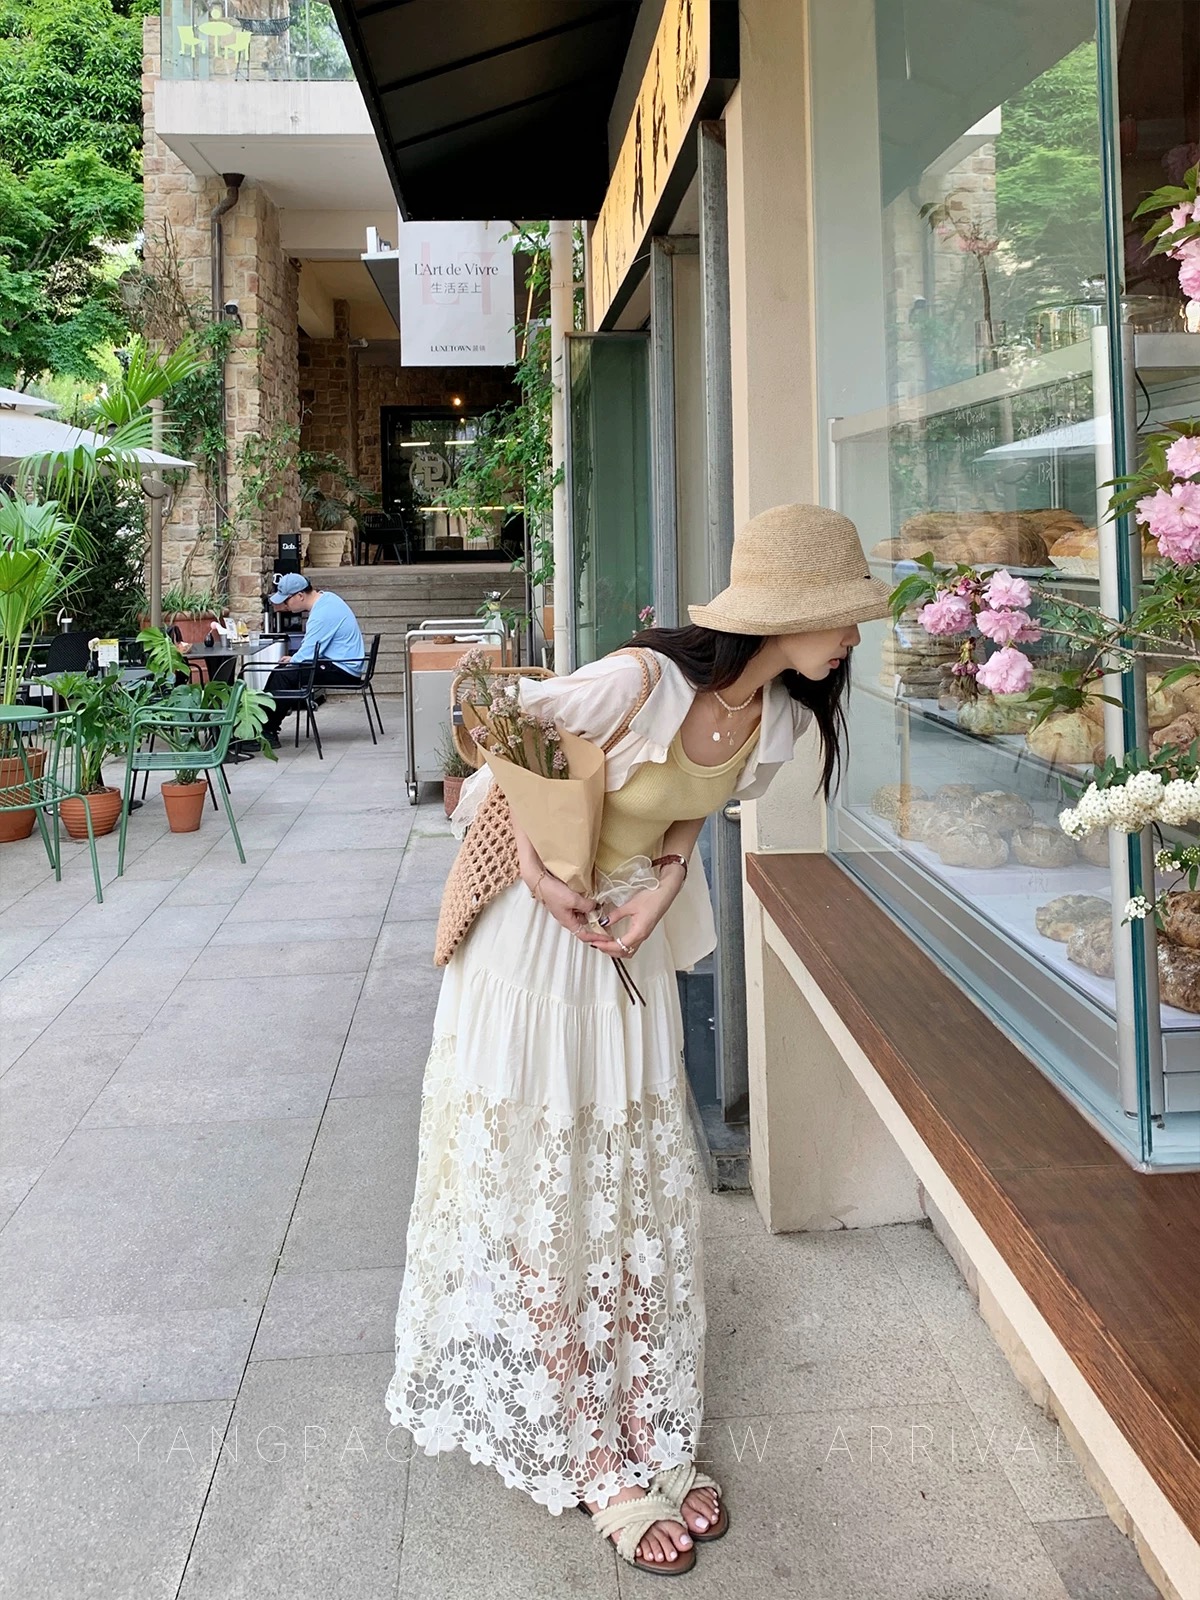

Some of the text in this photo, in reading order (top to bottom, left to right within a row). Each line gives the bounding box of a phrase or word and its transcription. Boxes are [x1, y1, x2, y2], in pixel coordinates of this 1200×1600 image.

[414, 263, 499, 276] L'Art de Vivre
[431, 282, 482, 294] 生活至上
